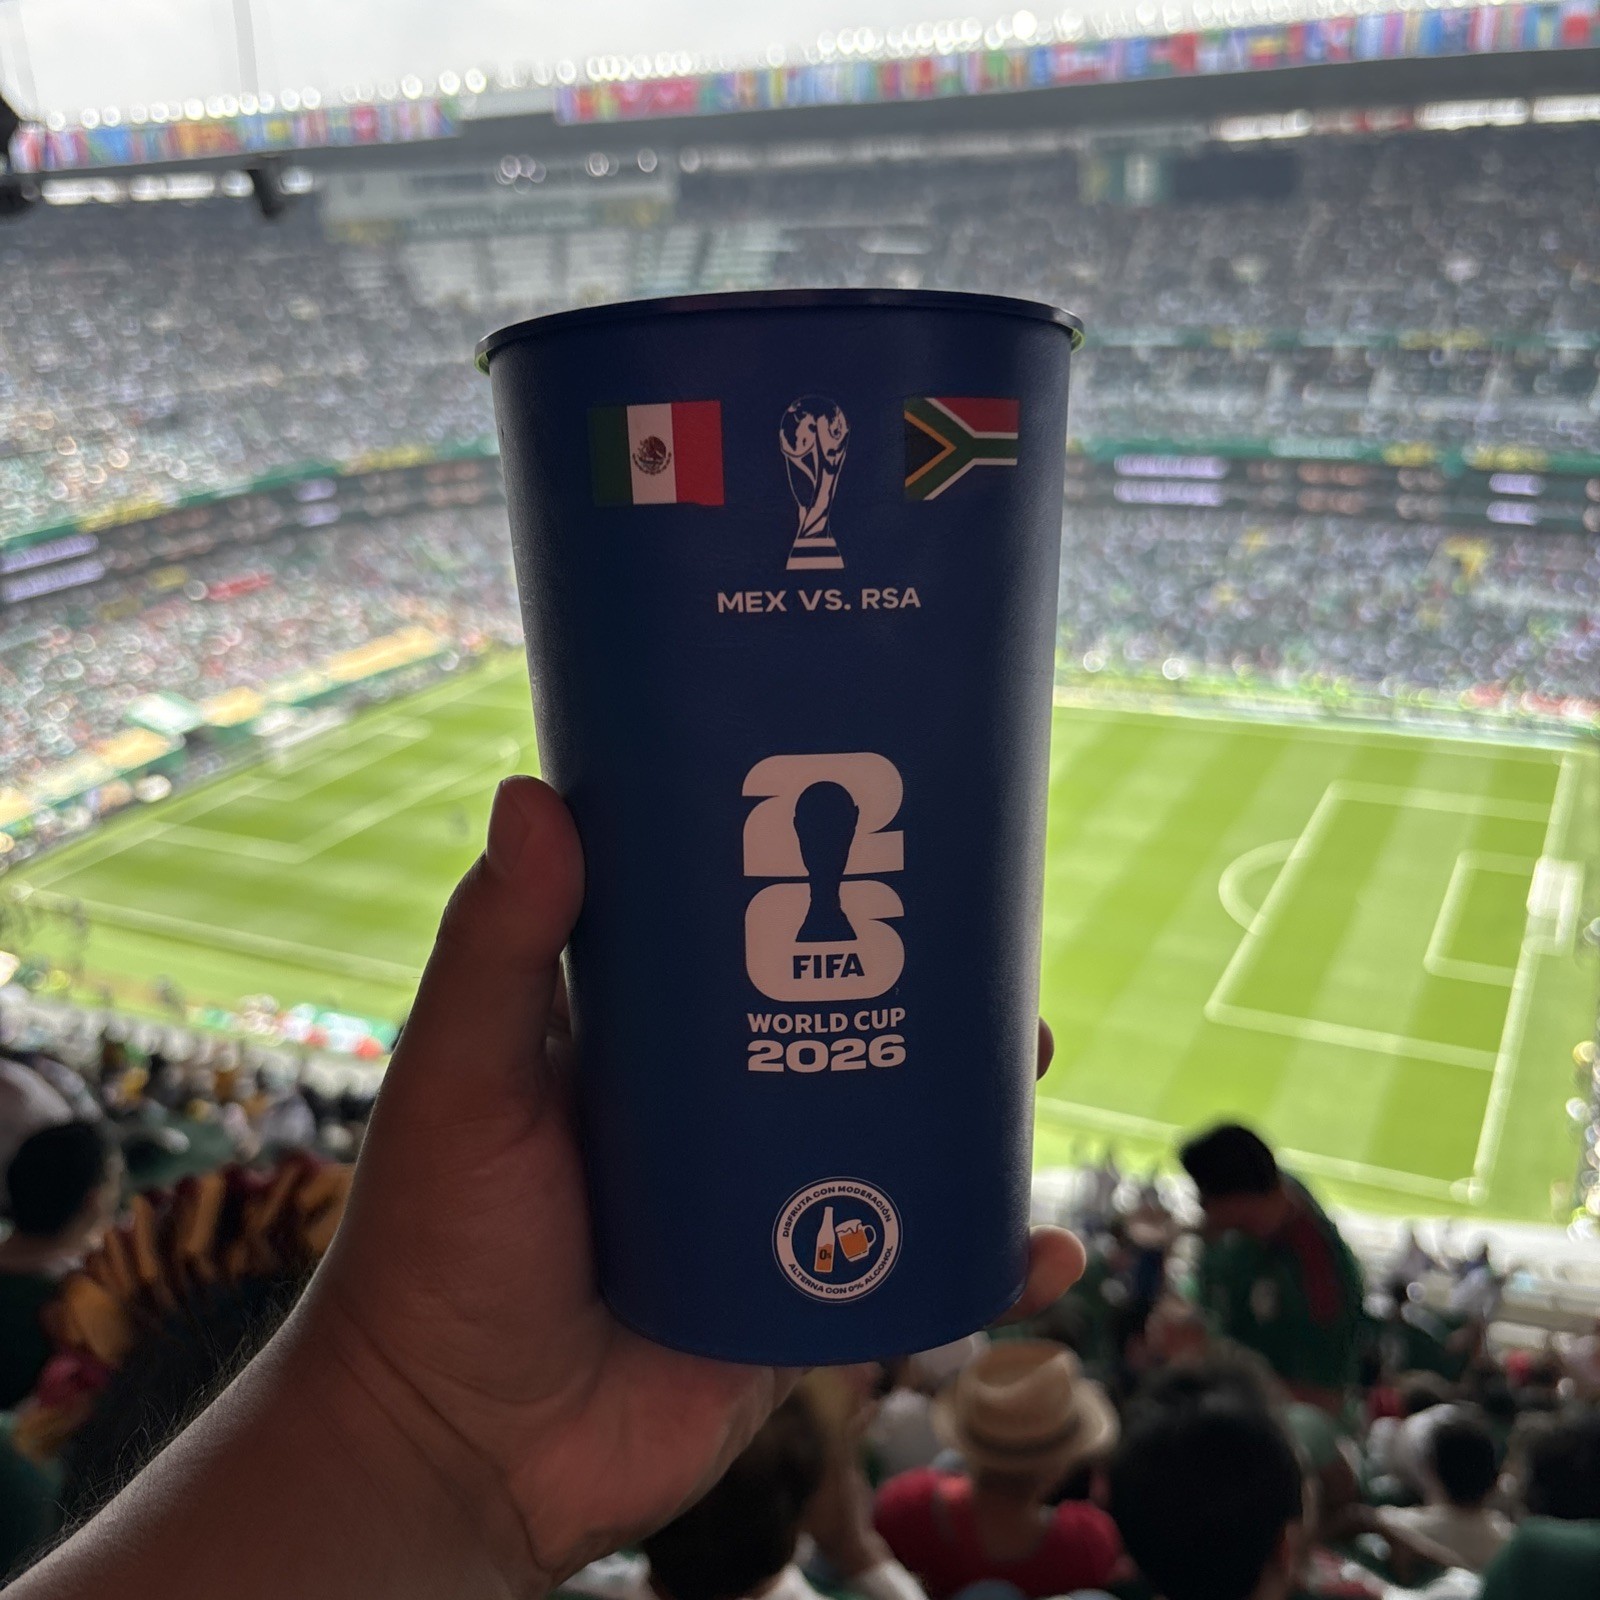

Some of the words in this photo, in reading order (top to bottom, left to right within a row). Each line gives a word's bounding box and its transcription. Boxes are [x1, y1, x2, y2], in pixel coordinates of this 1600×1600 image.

[717, 590, 787, 613] MEX
[798, 588, 851, 611] VS.
[861, 587, 921, 609] RSA
[792, 953, 865, 979] FIFA
[747, 1013, 849, 1034] WORLD
[853, 1007, 906, 1031] CUP
[747, 1034, 907, 1073] 2026
[782, 1195, 813, 1238] DISFRUTA
[812, 1186, 836, 1199] CON
[838, 1186, 892, 1222] MODERACIÓN
[788, 1262, 824, 1293] ALTERNA
[825, 1286, 847, 1295] CON
[848, 1282, 865, 1293] 0%
[864, 1245, 893, 1285] ALCOHOL
